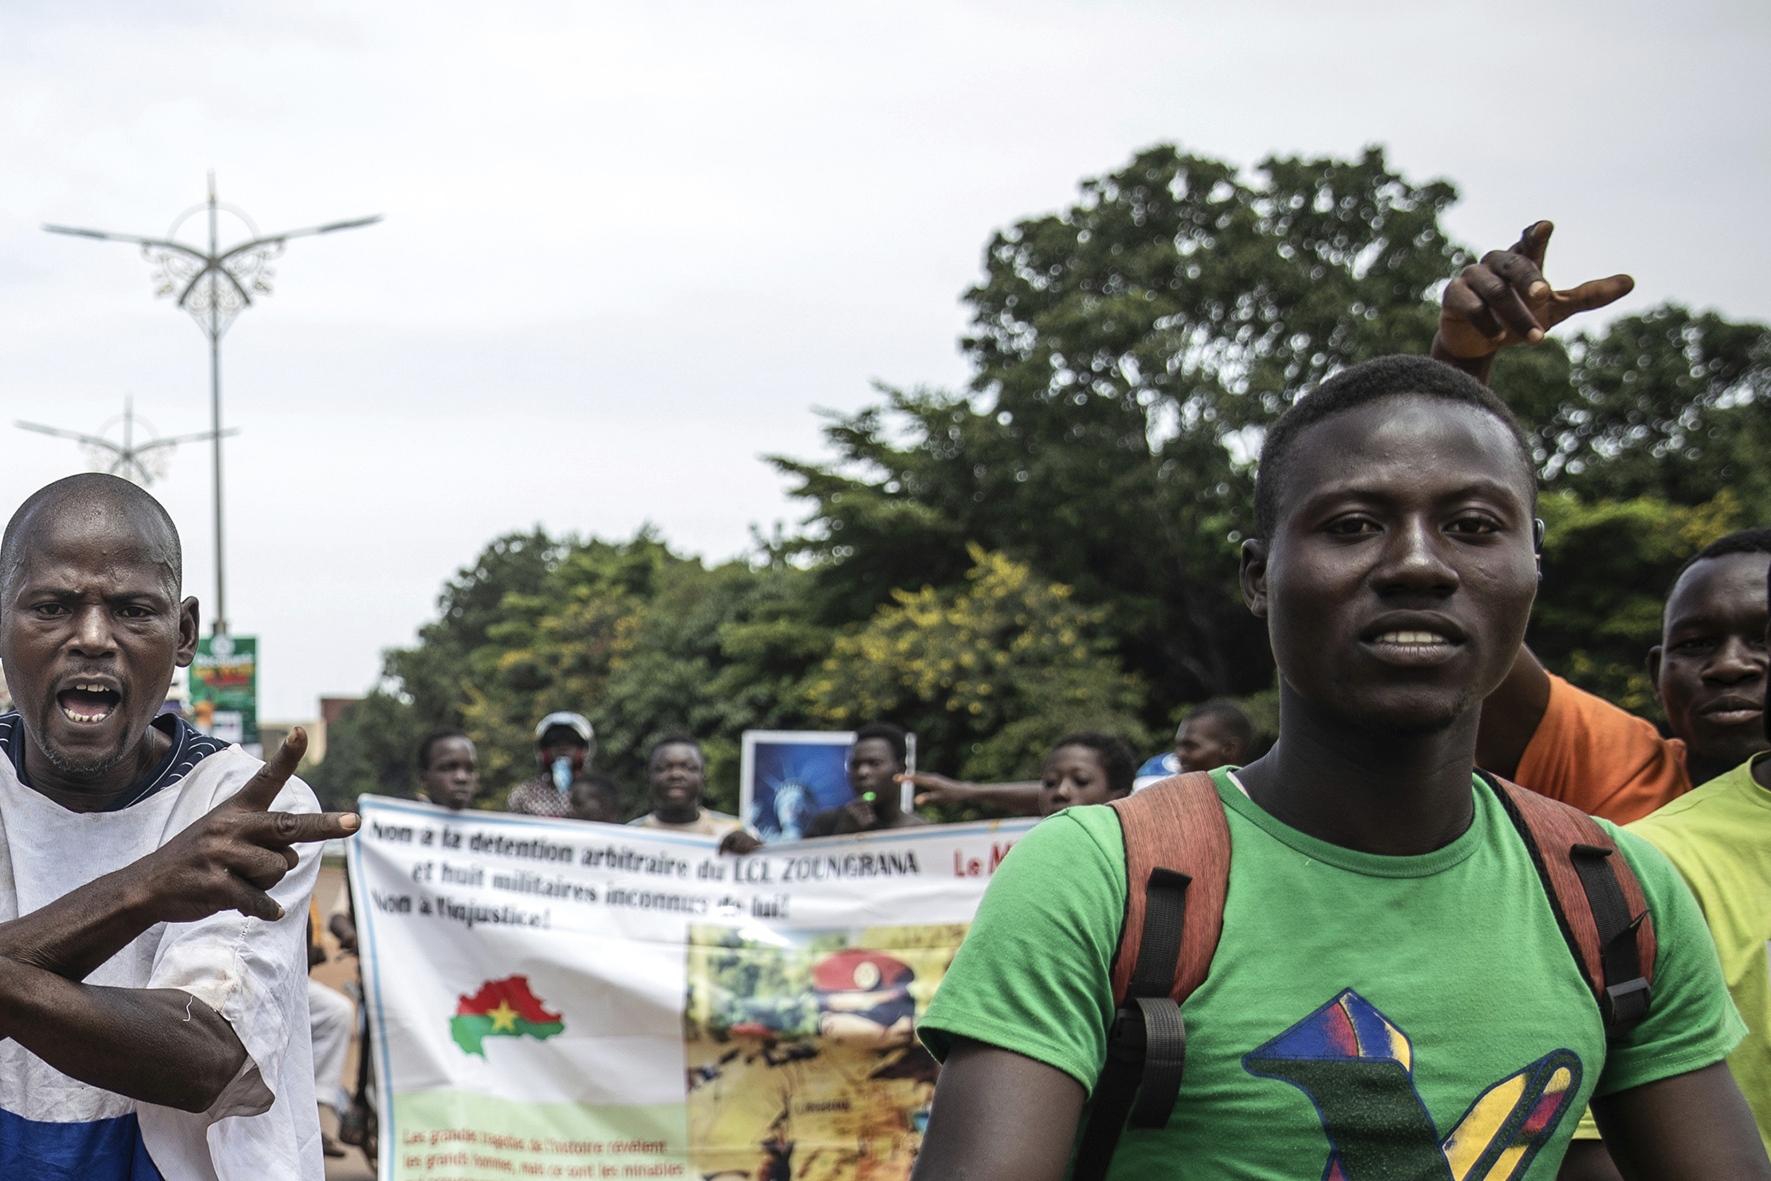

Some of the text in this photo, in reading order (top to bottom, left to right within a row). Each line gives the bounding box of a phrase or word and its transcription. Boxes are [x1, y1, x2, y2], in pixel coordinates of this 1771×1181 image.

[581, 843, 687, 878] arbitraire
[697, 855, 725, 880] du
[780, 849, 921, 881] ZOUNGRANA
[952, 850, 981, 878] Le
[441, 863, 484, 887] huit
[492, 870, 597, 902] militaires
